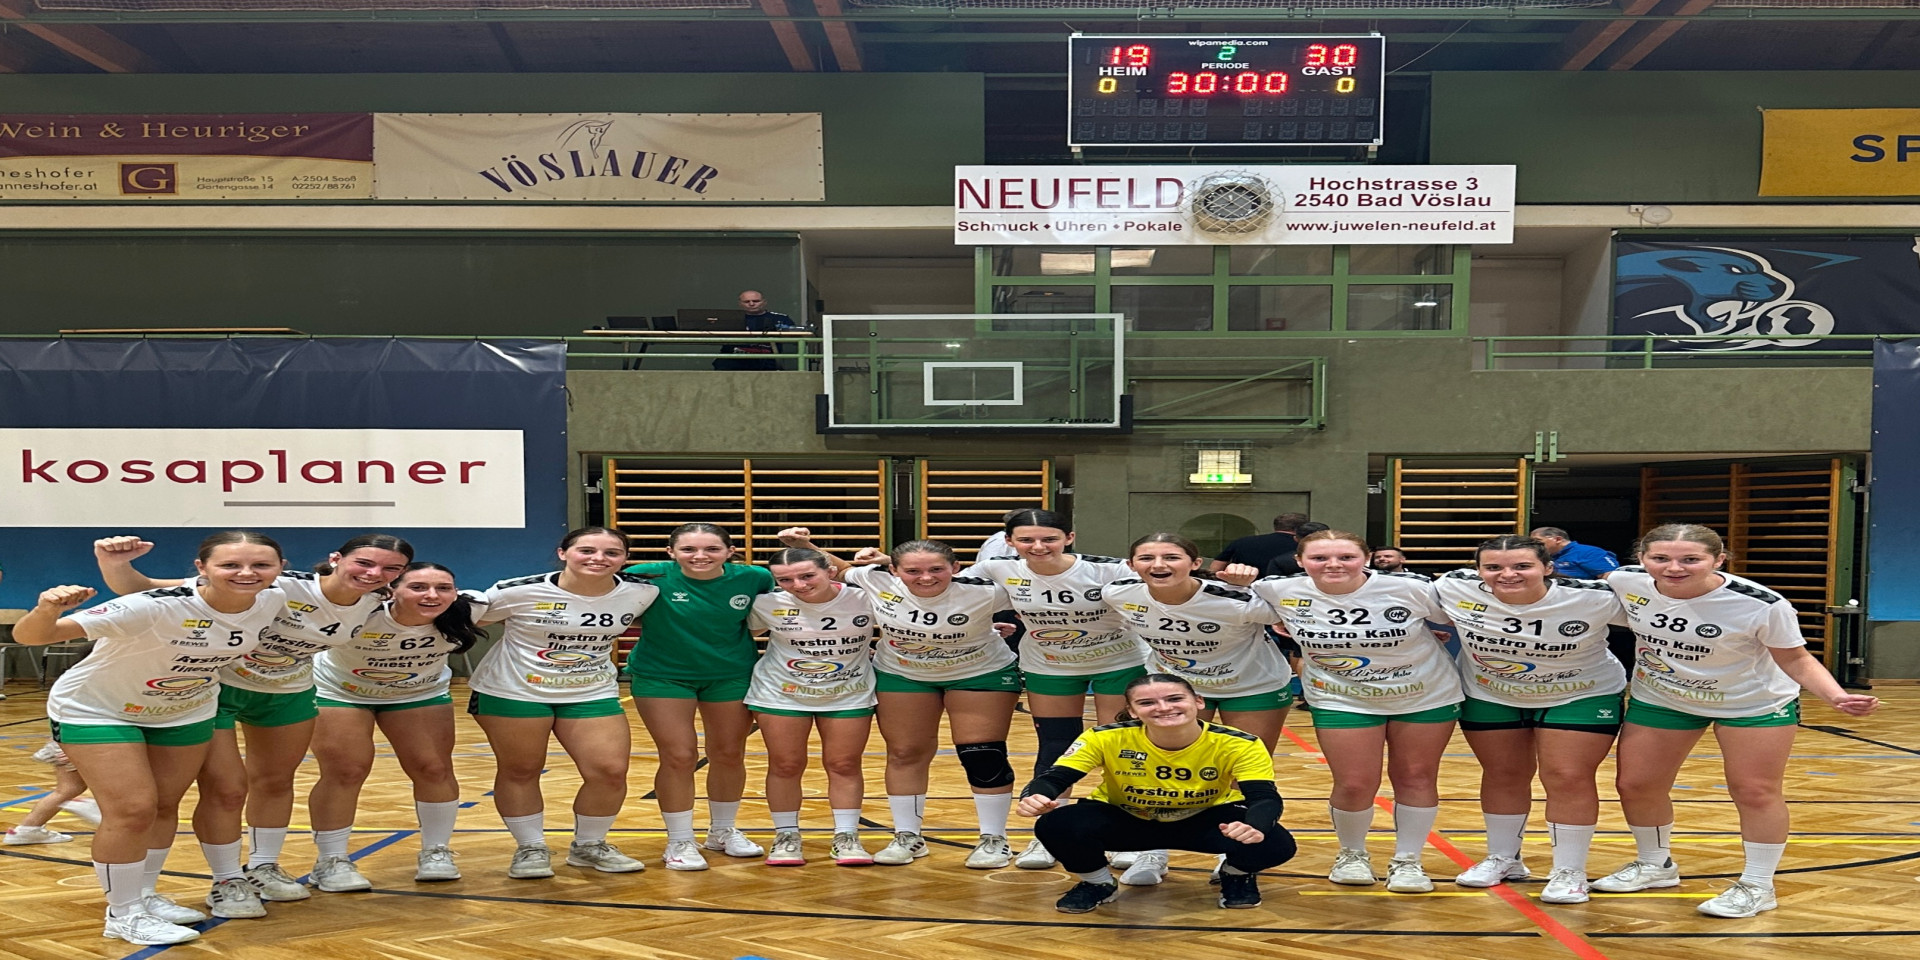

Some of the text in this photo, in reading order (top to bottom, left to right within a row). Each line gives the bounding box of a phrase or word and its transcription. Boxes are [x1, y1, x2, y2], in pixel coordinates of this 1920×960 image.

[1188, 39, 1268, 48] wipamedia.com
[1110, 46, 1150, 66] 19
[1217, 46, 1237, 60] 2
[1306, 45, 1357, 66] 30
[1099, 66, 1147, 76] HEIM
[1201, 62, 1250, 70] PERIODE
[1301, 66, 1356, 76] GAST
[1099, 77, 1117, 93] 0
[1168, 72, 1289, 93] 30:00
[1336, 77, 1355, 93] 0
[99, 122, 125, 138] &
[142, 121, 310, 143] Heuriger
[128, 167, 170, 191] G
[478, 150, 719, 194] VÖSLAUER
[196, 183, 259, 191] Gartengasse
[1309, 177, 1479, 191] Hochstrasse 3
[958, 177, 1185, 211] NEUFELD
[1295, 193, 1492, 208] 2540 Bad Vöslau
[957, 220, 1183, 233] Schmuck Uhren Pokale
[1286, 220, 1496, 235] www.juwelen-neufeld.at
[22, 449, 487, 493] kosaplaner
[1041, 589, 1075, 604] 16
[580, 612, 614, 627] 28
[820, 617, 838, 631] 2
[908, 609, 938, 626] 19
[1327, 608, 1371, 626] 32
[1650, 613, 1689, 633] 38
[319, 622, 341, 636] 4
[1158, 617, 1190, 633] 23
[1502, 617, 1544, 637] 31
[227, 630, 244, 647] 5
[932, 632, 966, 640] Kalb
[1365, 628, 1407, 639] Kalb
[400, 636, 436, 650] 62
[1055, 639, 1137, 662] NUSSBAUM
[1185, 639, 1219, 647] Kalb
[1534, 642, 1577, 651] Kalb
[1673, 641, 1712, 654] Kalb
[1323, 681, 1424, 698] NUSSBAUM
[1489, 679, 1596, 695] NUSSBAUM
[1155, 765, 1192, 781] 89
[1184, 787, 1219, 799] Kalb
